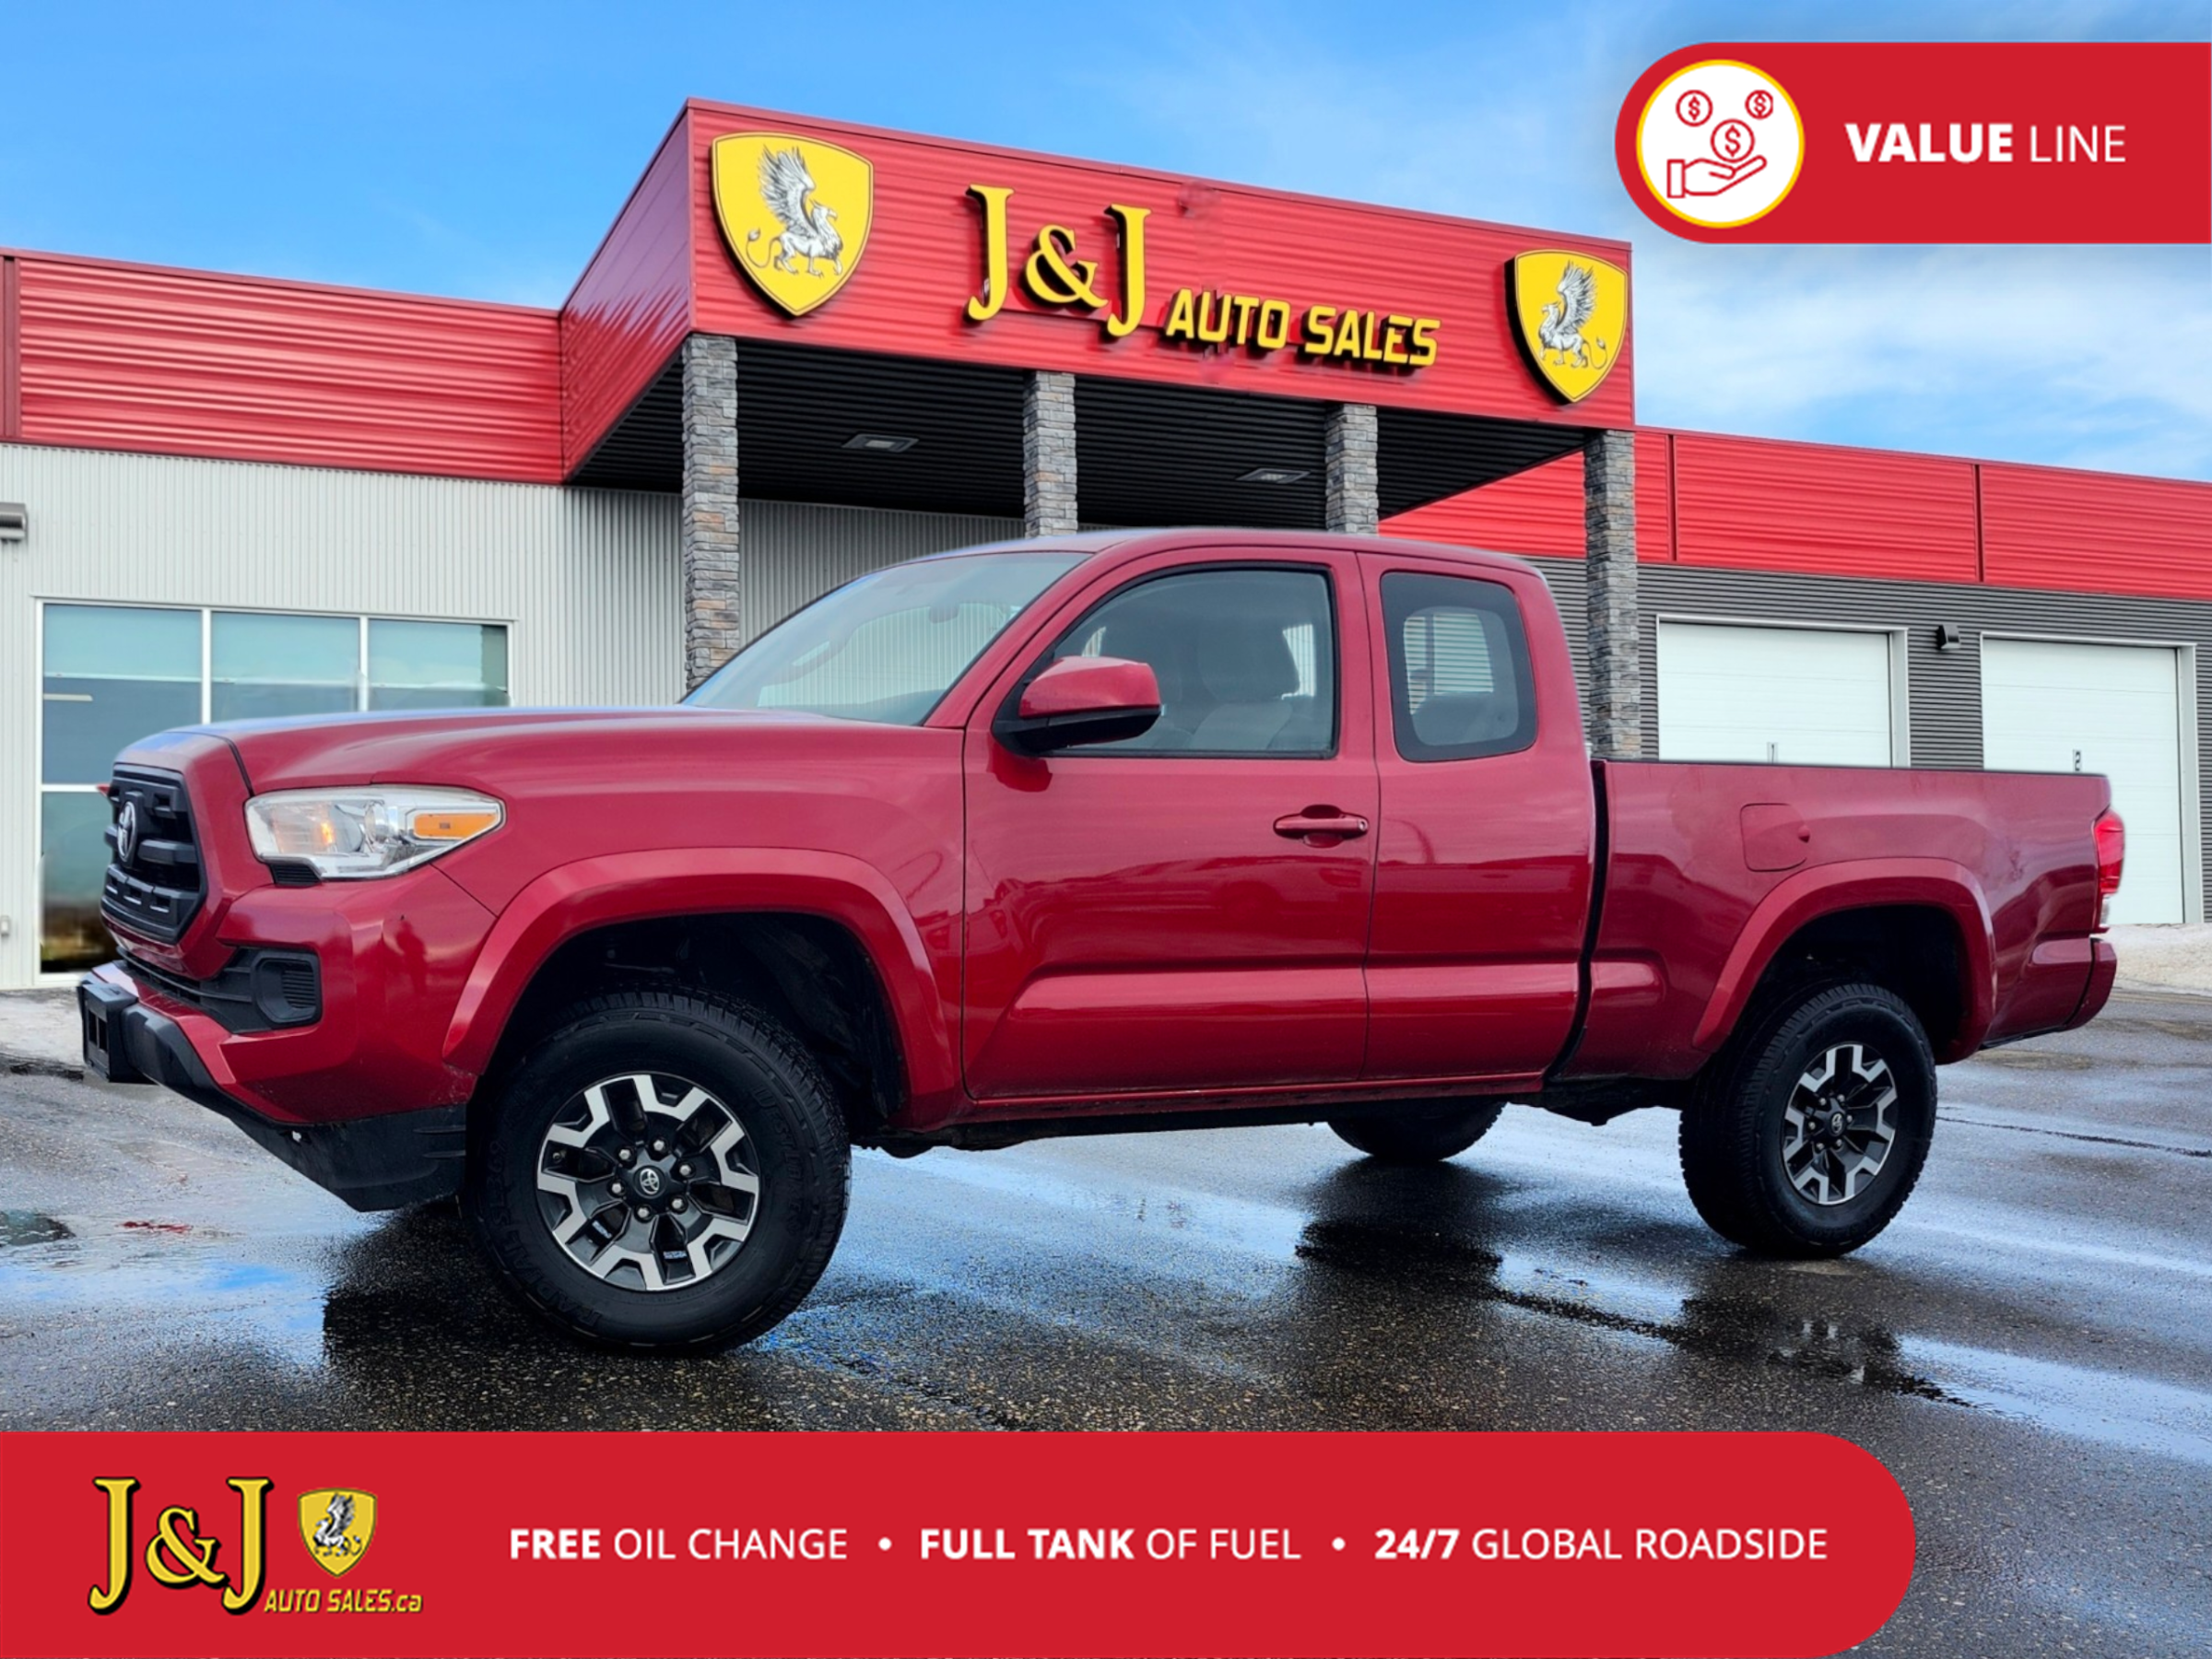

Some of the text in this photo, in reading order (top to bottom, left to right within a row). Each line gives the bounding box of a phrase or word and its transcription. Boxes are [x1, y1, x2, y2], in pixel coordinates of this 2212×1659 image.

[966, 183, 1152, 338] J&J
[1165, 288, 1441, 367] AUTO SALES
[2074, 750, 2082, 772] 2
